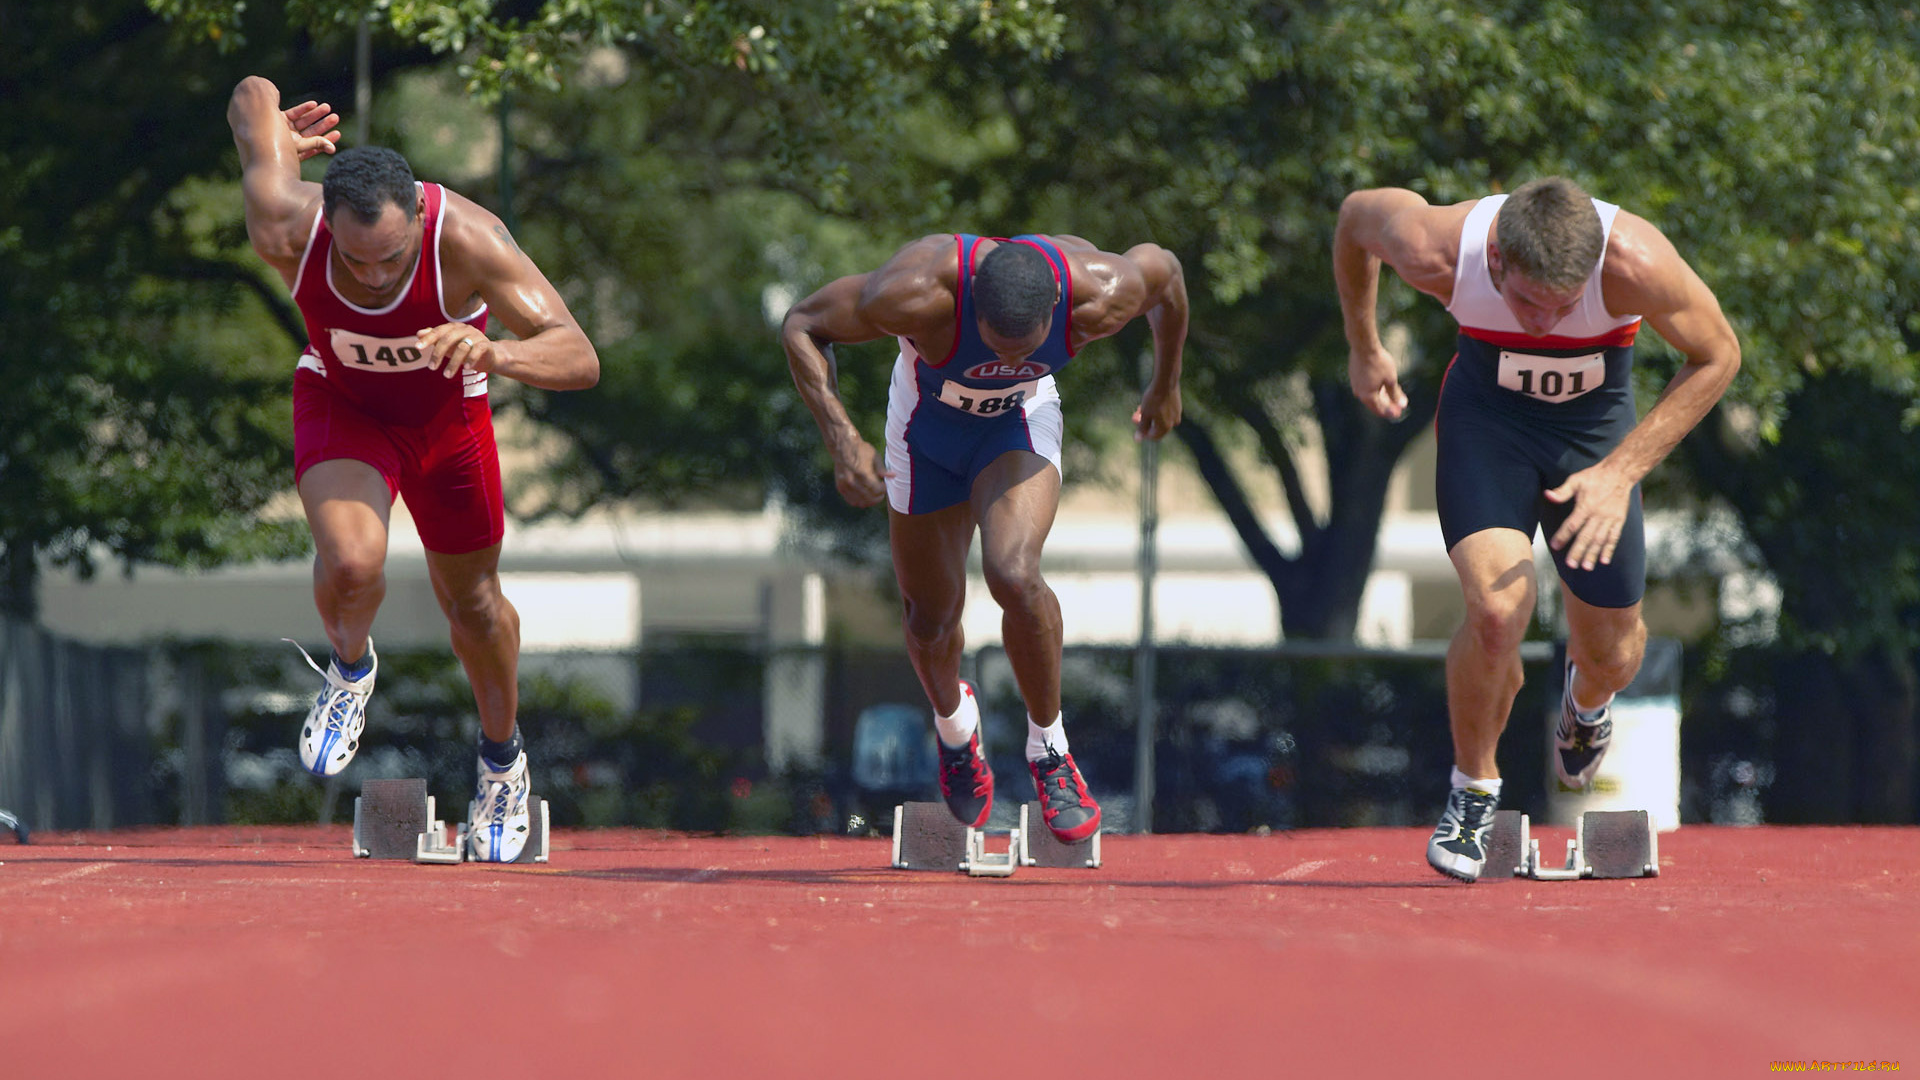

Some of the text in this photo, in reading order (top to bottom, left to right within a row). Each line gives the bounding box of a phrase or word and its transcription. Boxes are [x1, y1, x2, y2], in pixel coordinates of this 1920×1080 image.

[349, 343, 422, 367] 140
[980, 365, 1035, 376] USA
[1518, 369, 1586, 396] 101
[960, 390, 1026, 413] 188
